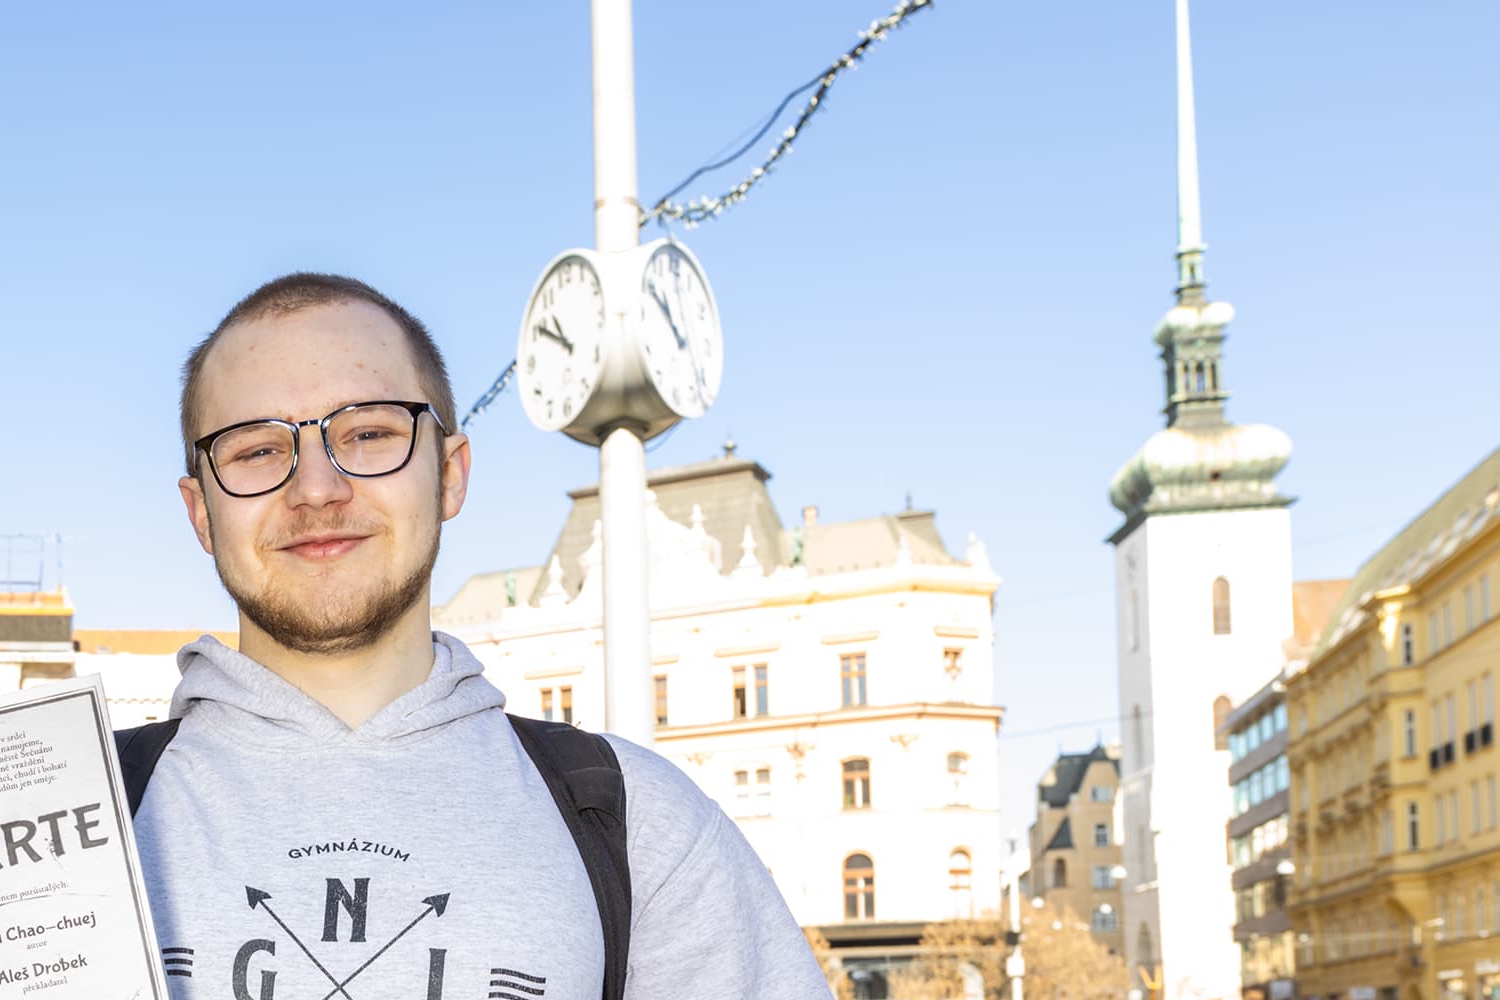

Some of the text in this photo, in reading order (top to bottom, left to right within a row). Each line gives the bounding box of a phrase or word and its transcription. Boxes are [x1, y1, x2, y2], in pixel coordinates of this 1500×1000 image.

[6, 730, 27, 742] srdci
[11, 755, 45, 769] vraždění
[13, 767, 36, 780] chudí
[42, 759, 68, 773] bohatí
[19, 780, 32, 791] jen
[287, 838, 411, 863] GYMNÁZIUM
[320, 877, 371, 943] N
[26, 940, 48, 950] autor
[32, 953, 88, 978] Drobek
[22, 976, 68, 996] překladatel
